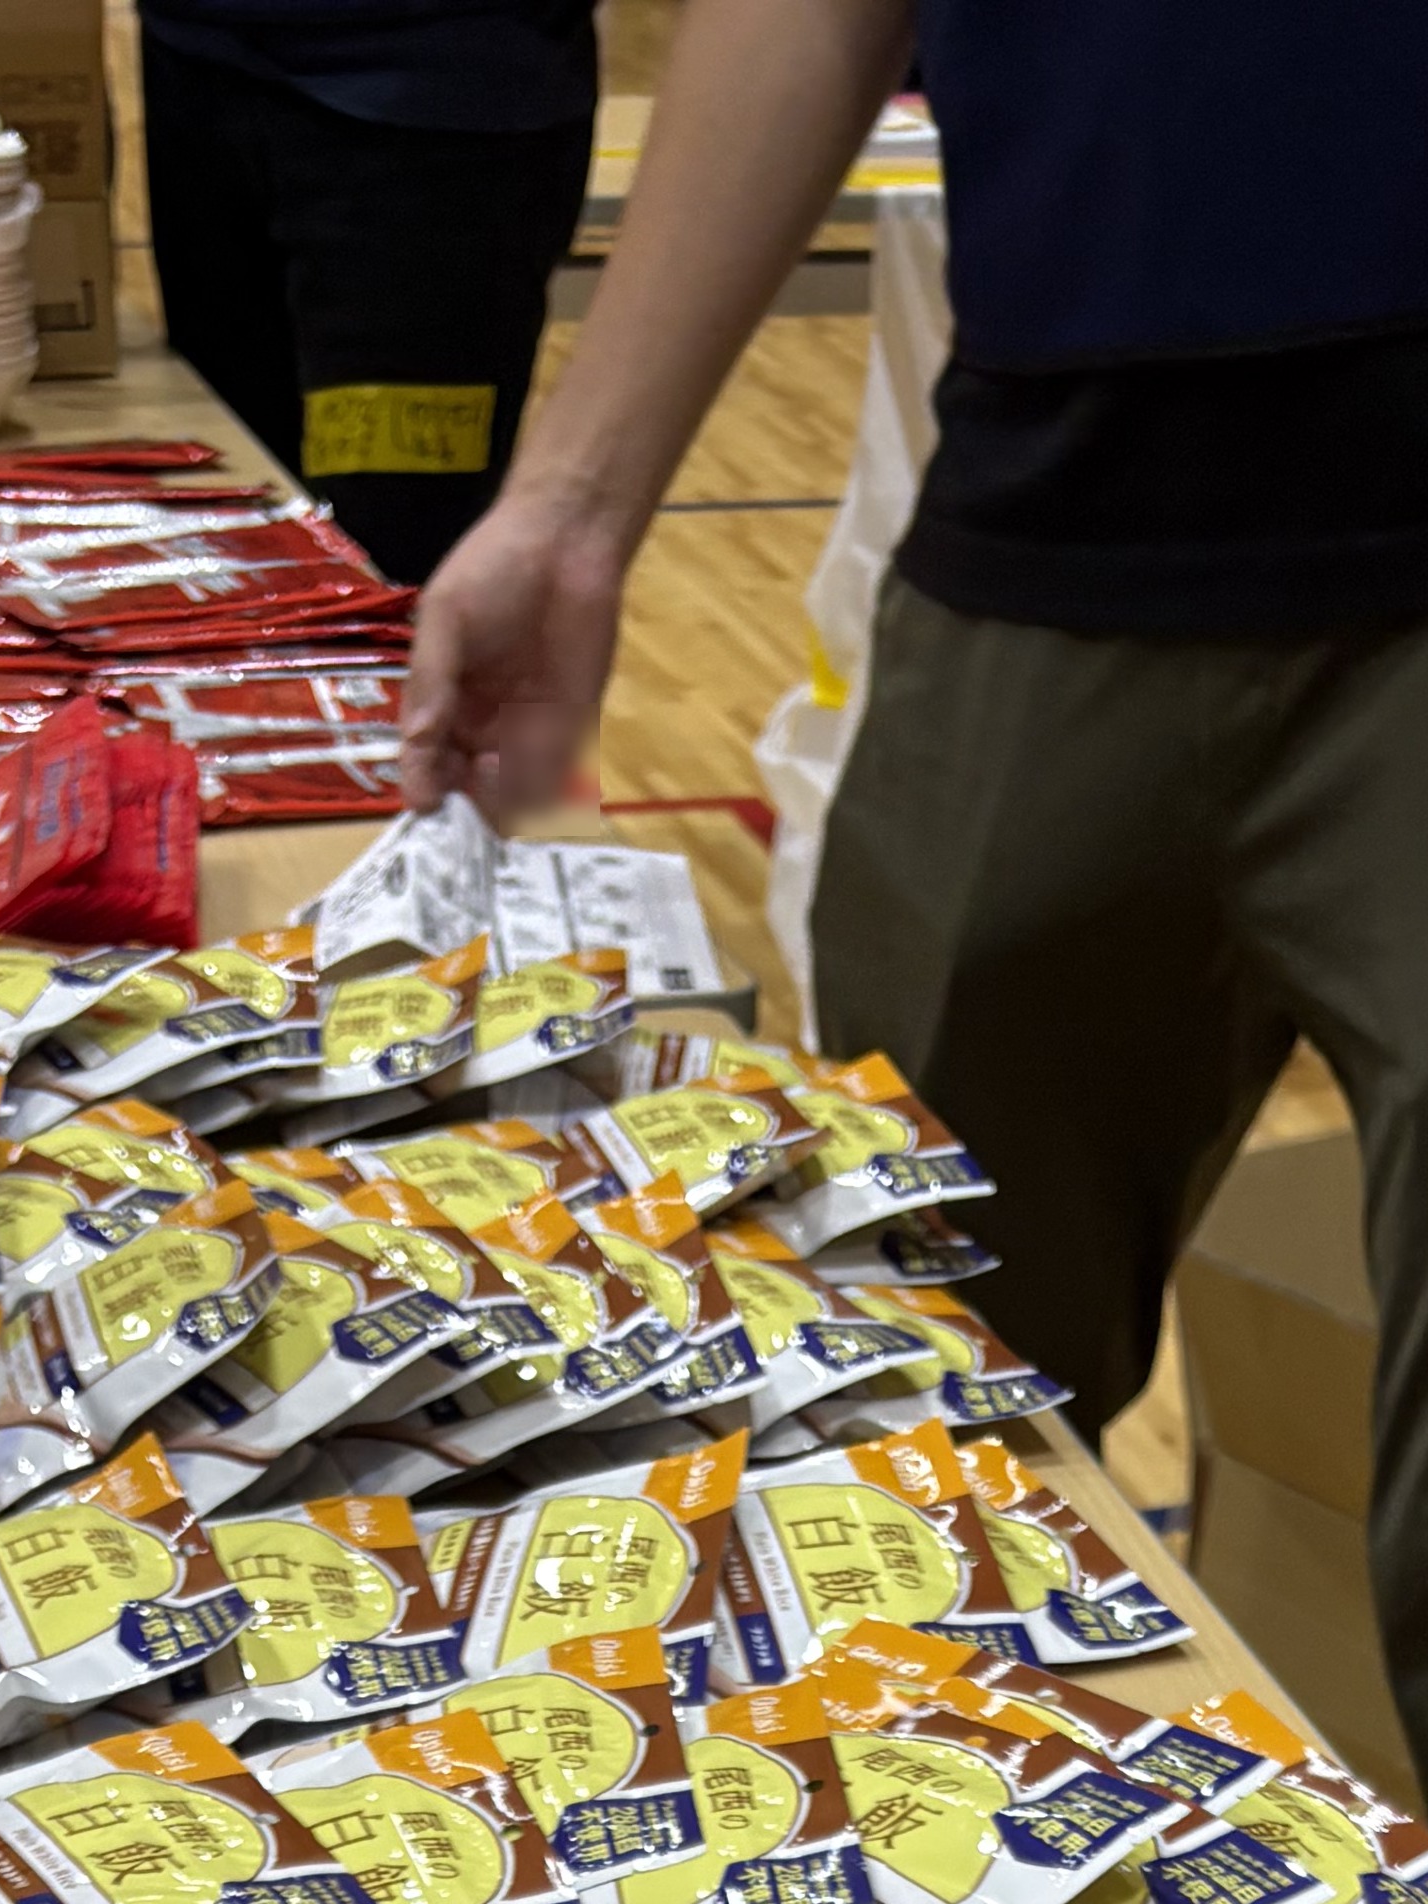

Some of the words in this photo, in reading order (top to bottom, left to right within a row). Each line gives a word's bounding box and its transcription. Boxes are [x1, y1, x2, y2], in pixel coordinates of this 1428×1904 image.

[785, 1517, 887, 1611] 白飯
[868, 1522, 925, 1589] 尾西の
[702, 1768, 757, 1830] 尾西の
[47, 1802, 185, 1884] 白飯
